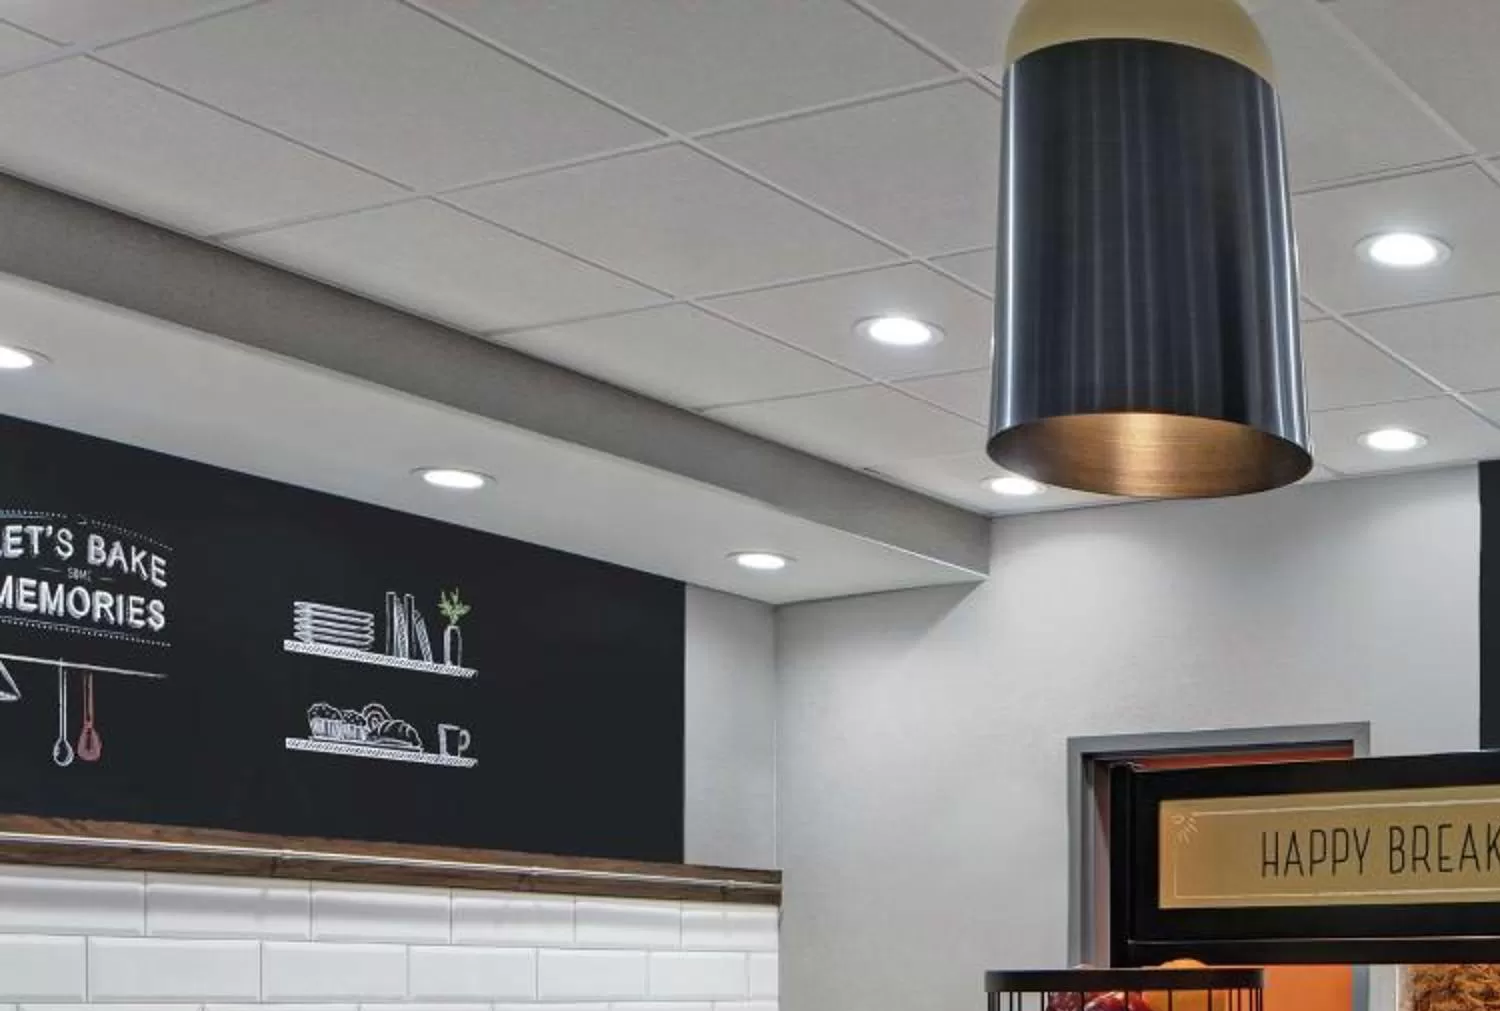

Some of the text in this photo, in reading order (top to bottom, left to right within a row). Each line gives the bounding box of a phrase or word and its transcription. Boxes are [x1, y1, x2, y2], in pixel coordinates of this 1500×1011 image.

[0, 525, 168, 588] ET'S BAKE
[1261, 826, 1370, 878] HAPPY
